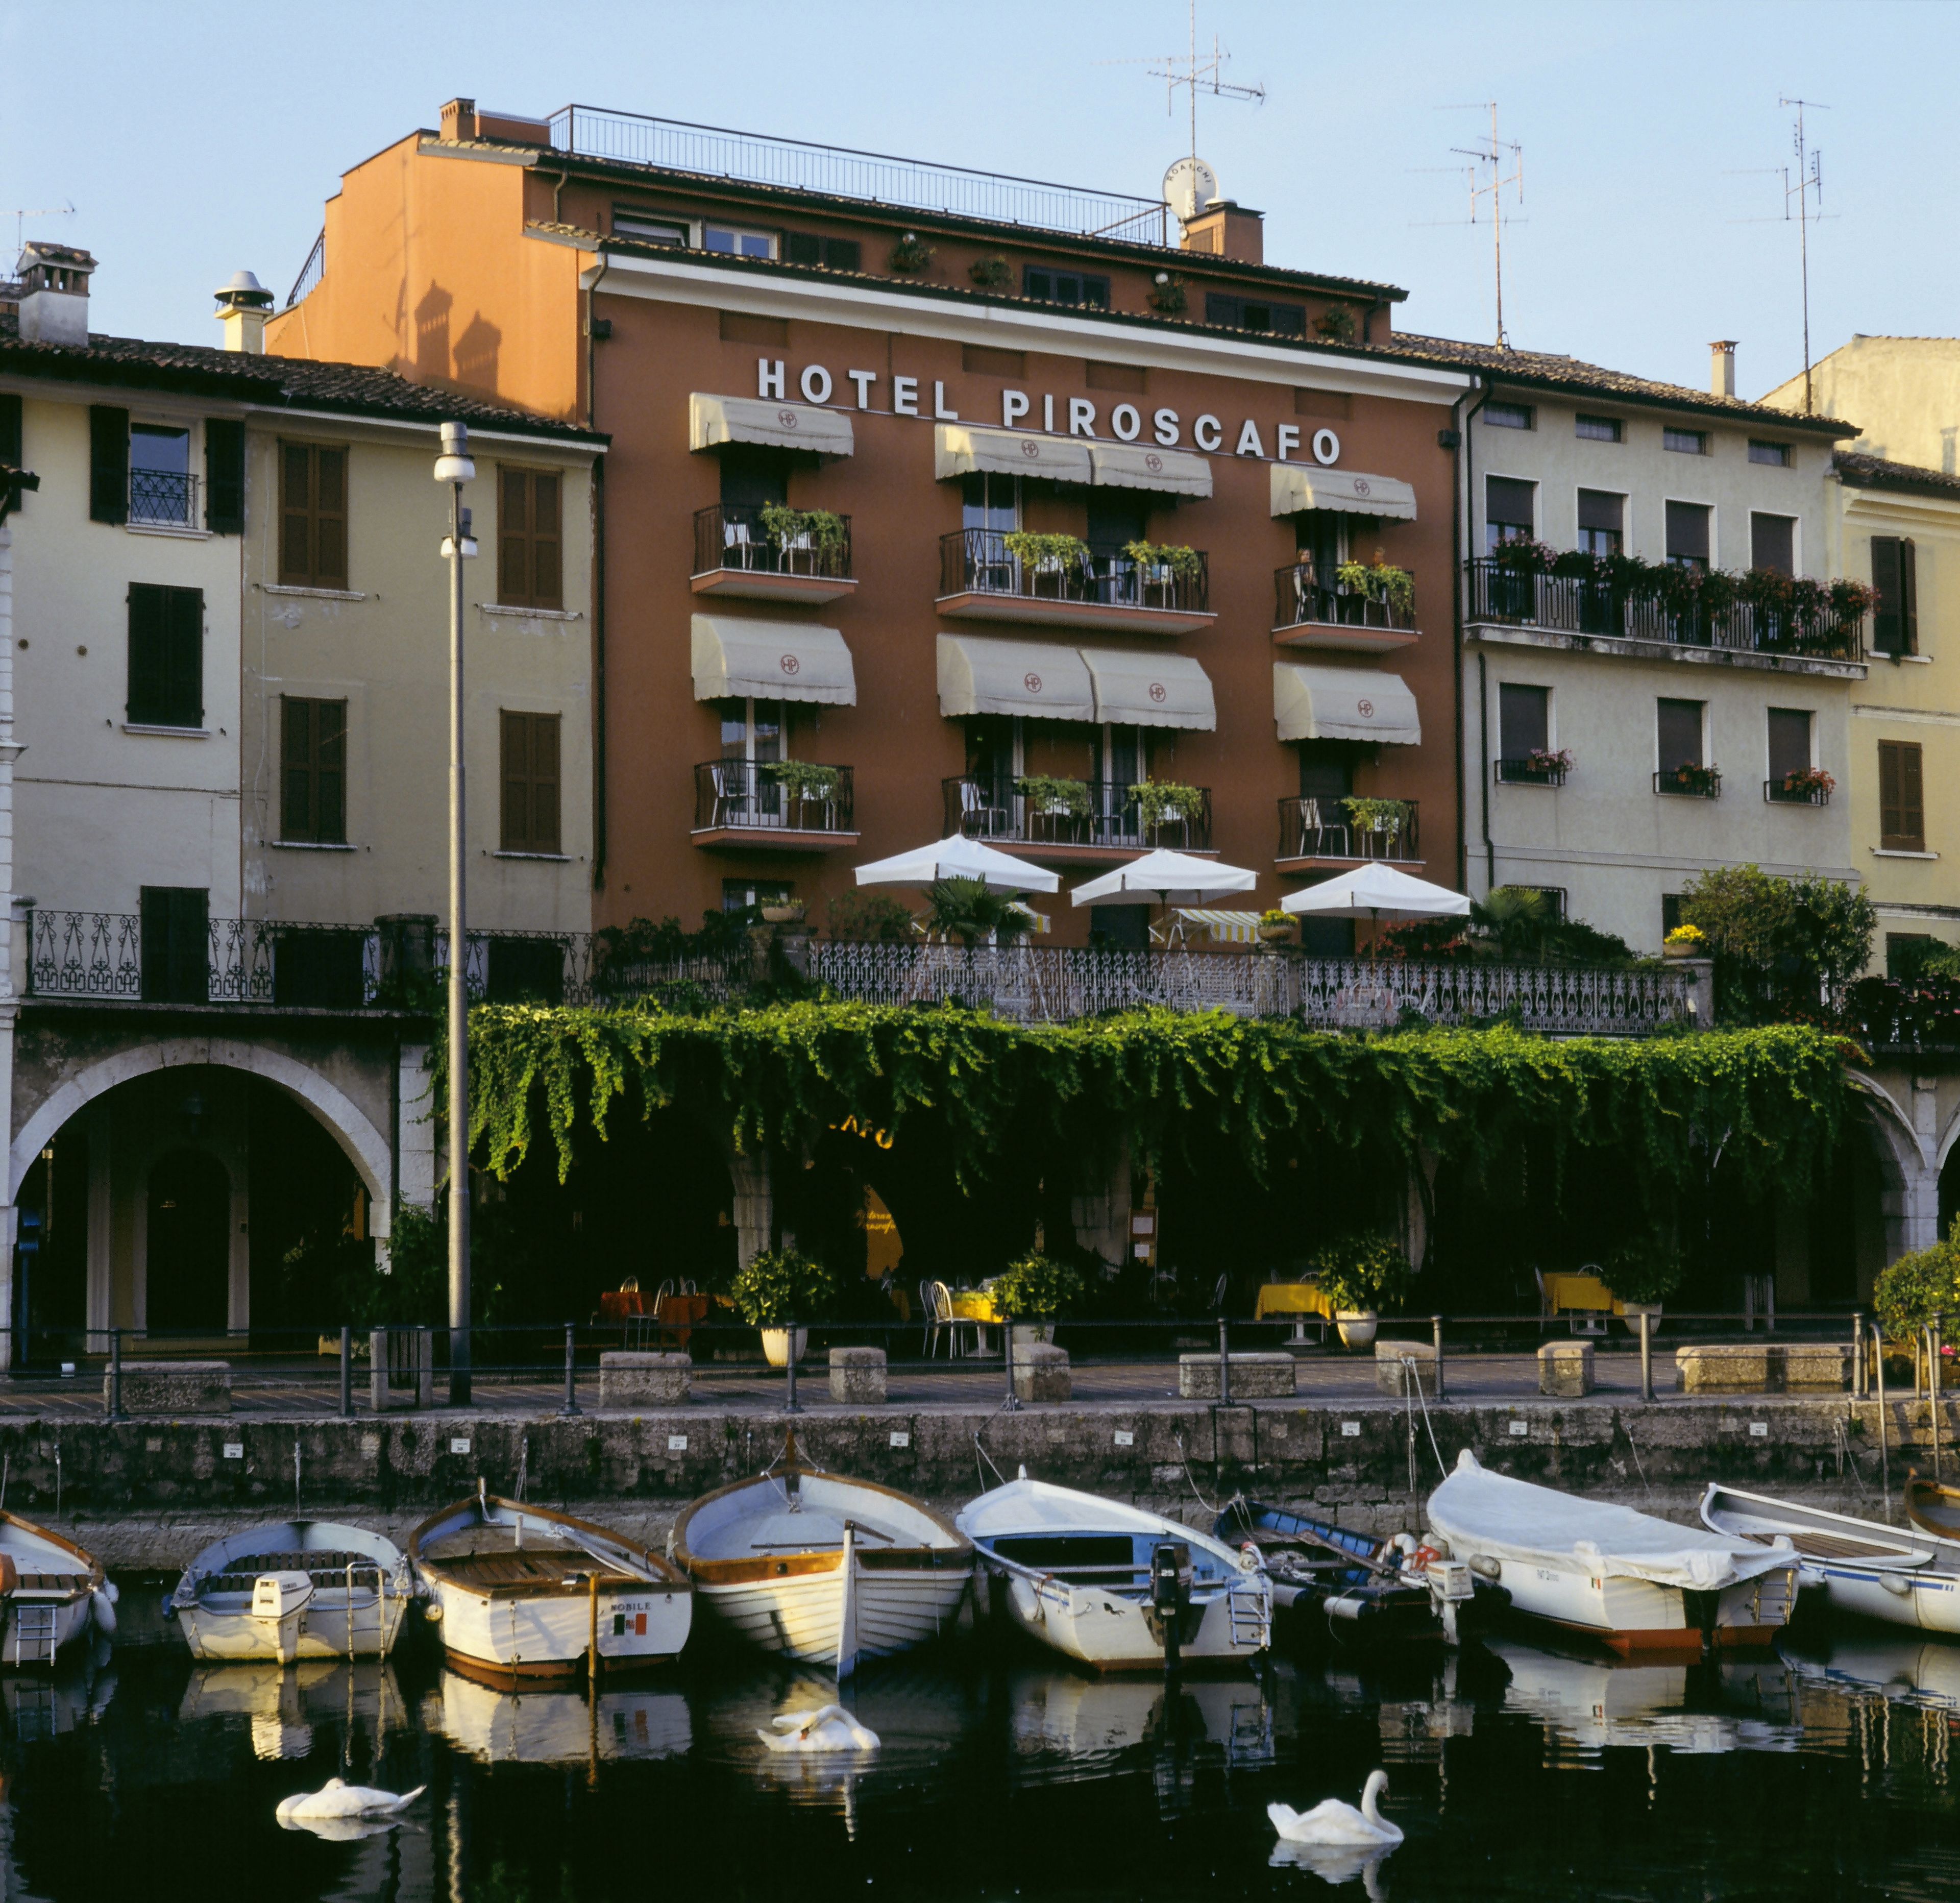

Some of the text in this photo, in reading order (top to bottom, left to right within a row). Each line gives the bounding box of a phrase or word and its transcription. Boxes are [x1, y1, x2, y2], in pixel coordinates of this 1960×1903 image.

[758, 358, 1340, 465] HOTEL PIROSCAFO
[611, 1602, 651, 1611] NOBILE
